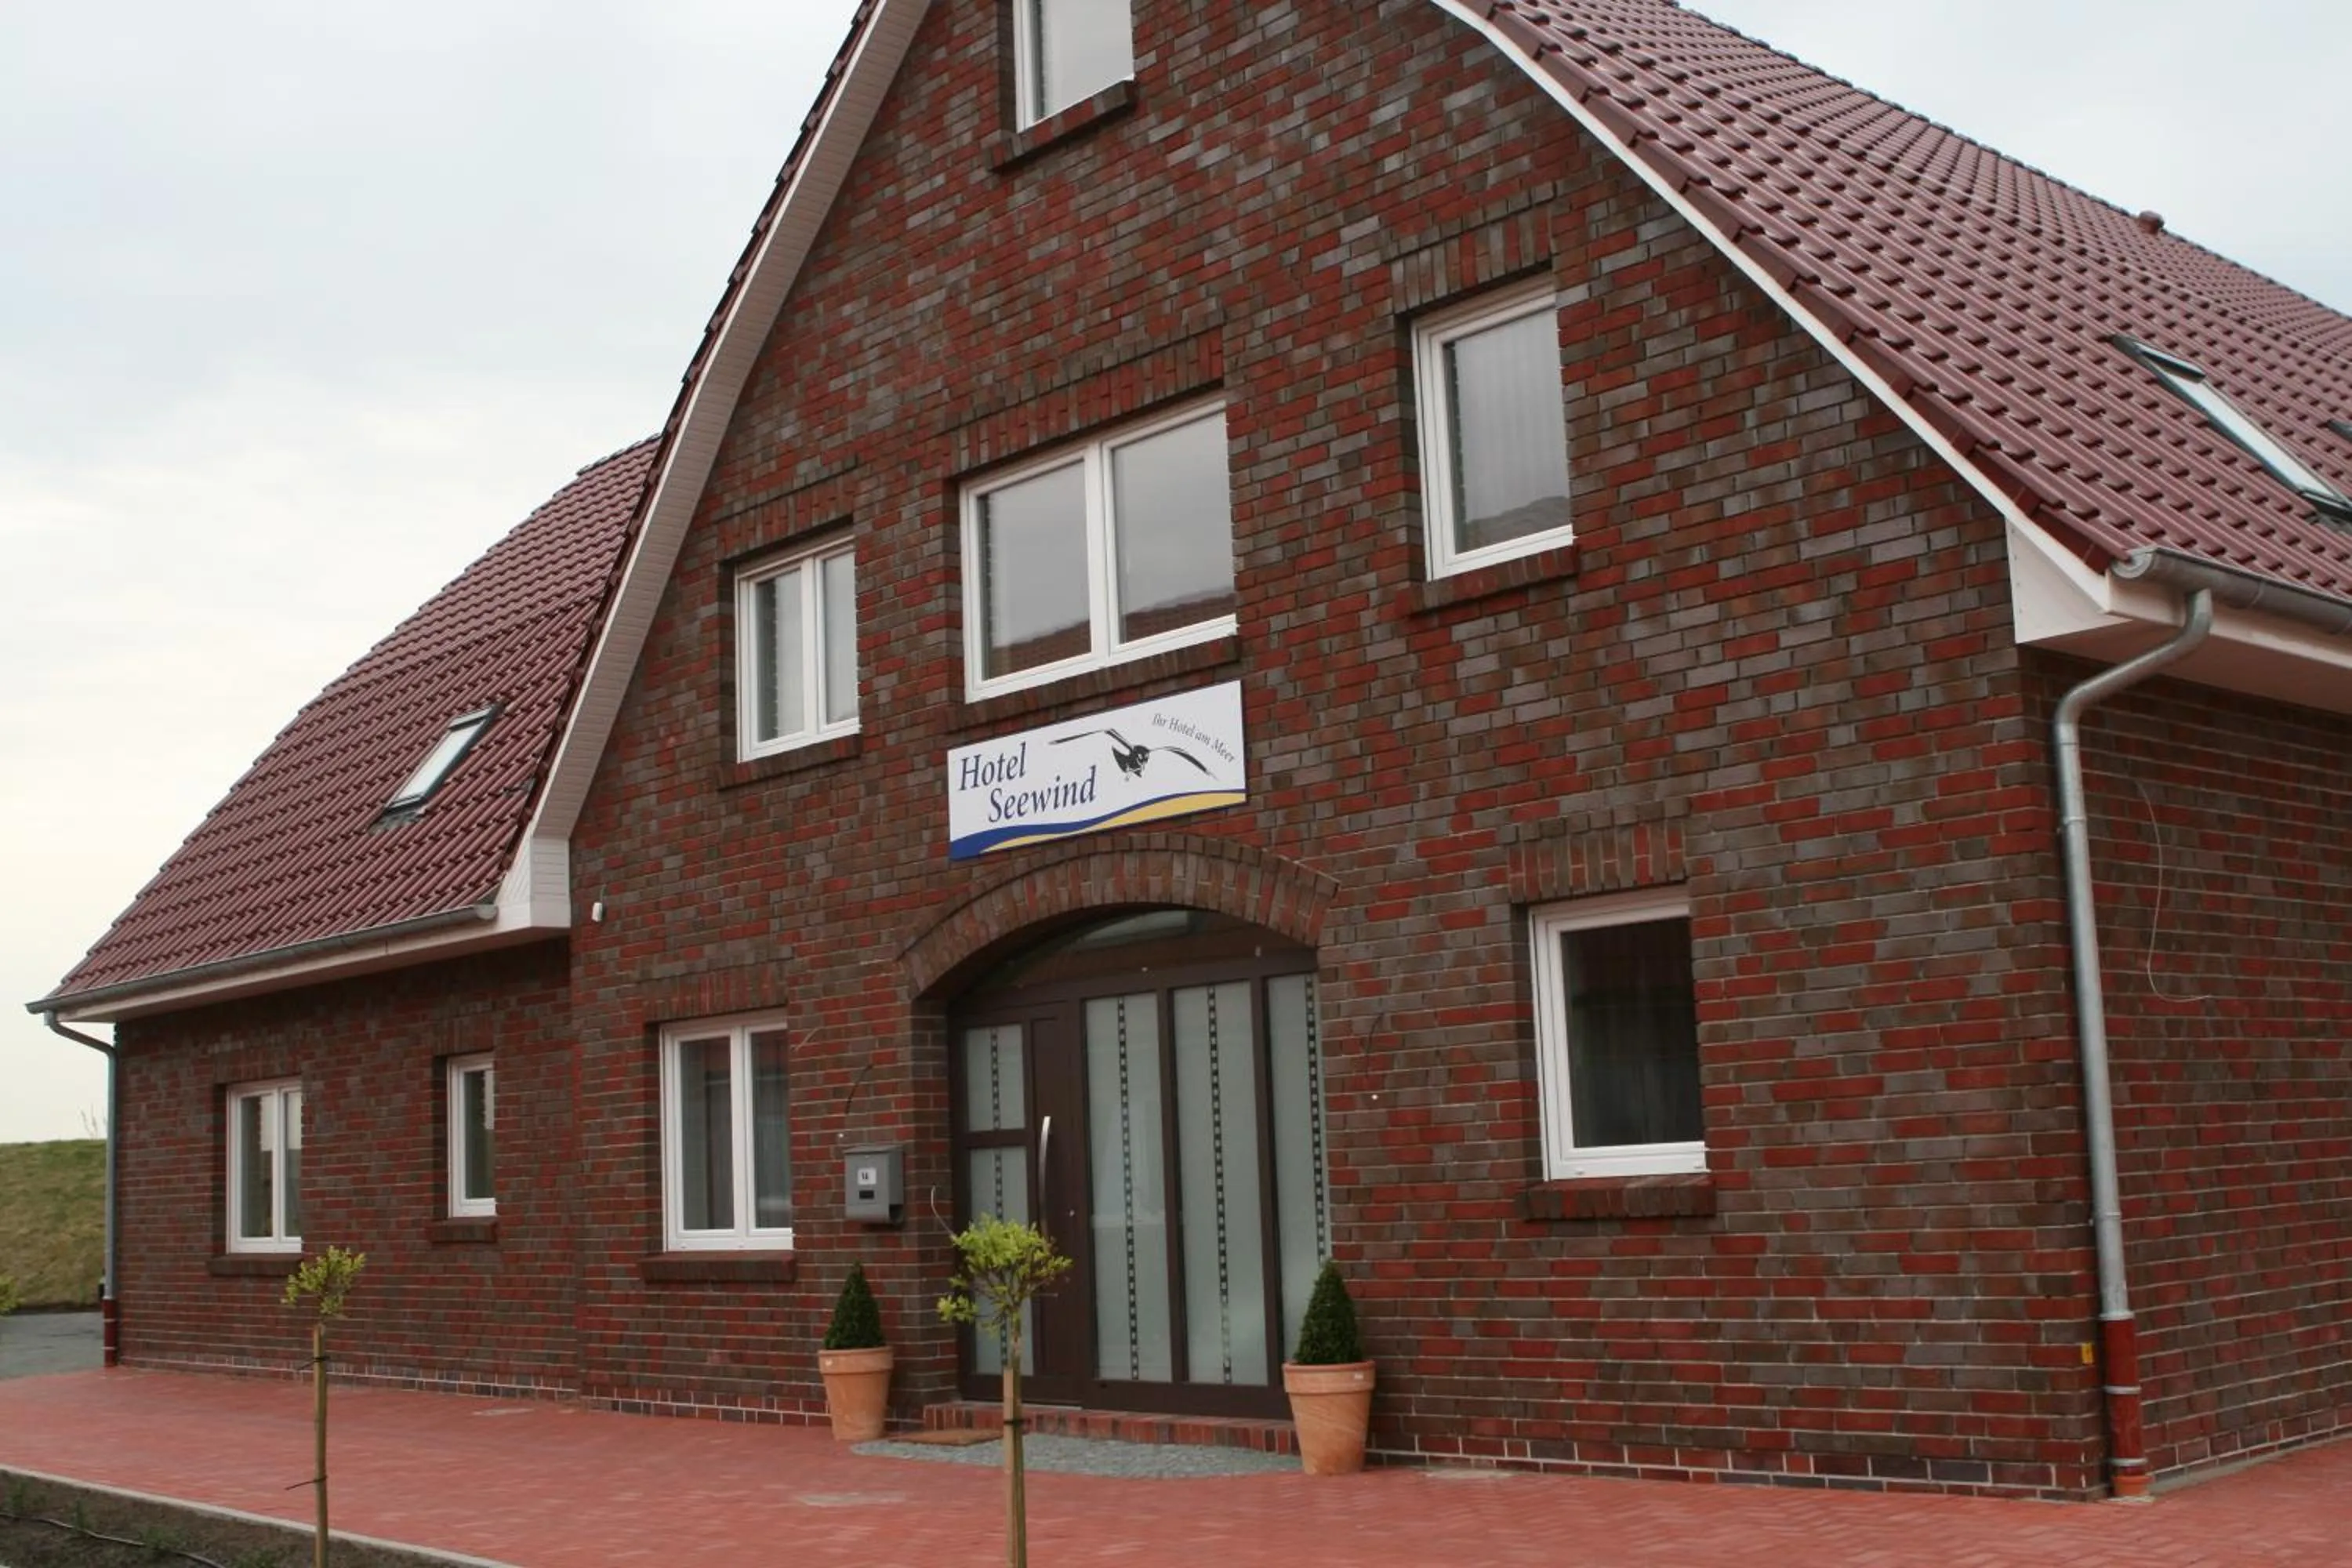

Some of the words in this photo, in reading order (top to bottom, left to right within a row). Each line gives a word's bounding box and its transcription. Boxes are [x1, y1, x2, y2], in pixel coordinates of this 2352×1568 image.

[1152, 713, 1169, 728] Ihr
[1169, 717, 1196, 737] Hotel
[1195, 731, 1210, 746] am
[1210, 739, 1235, 763] Meer
[960, 741, 1026, 791] Hotel
[989, 765, 1096, 823] Seewind
